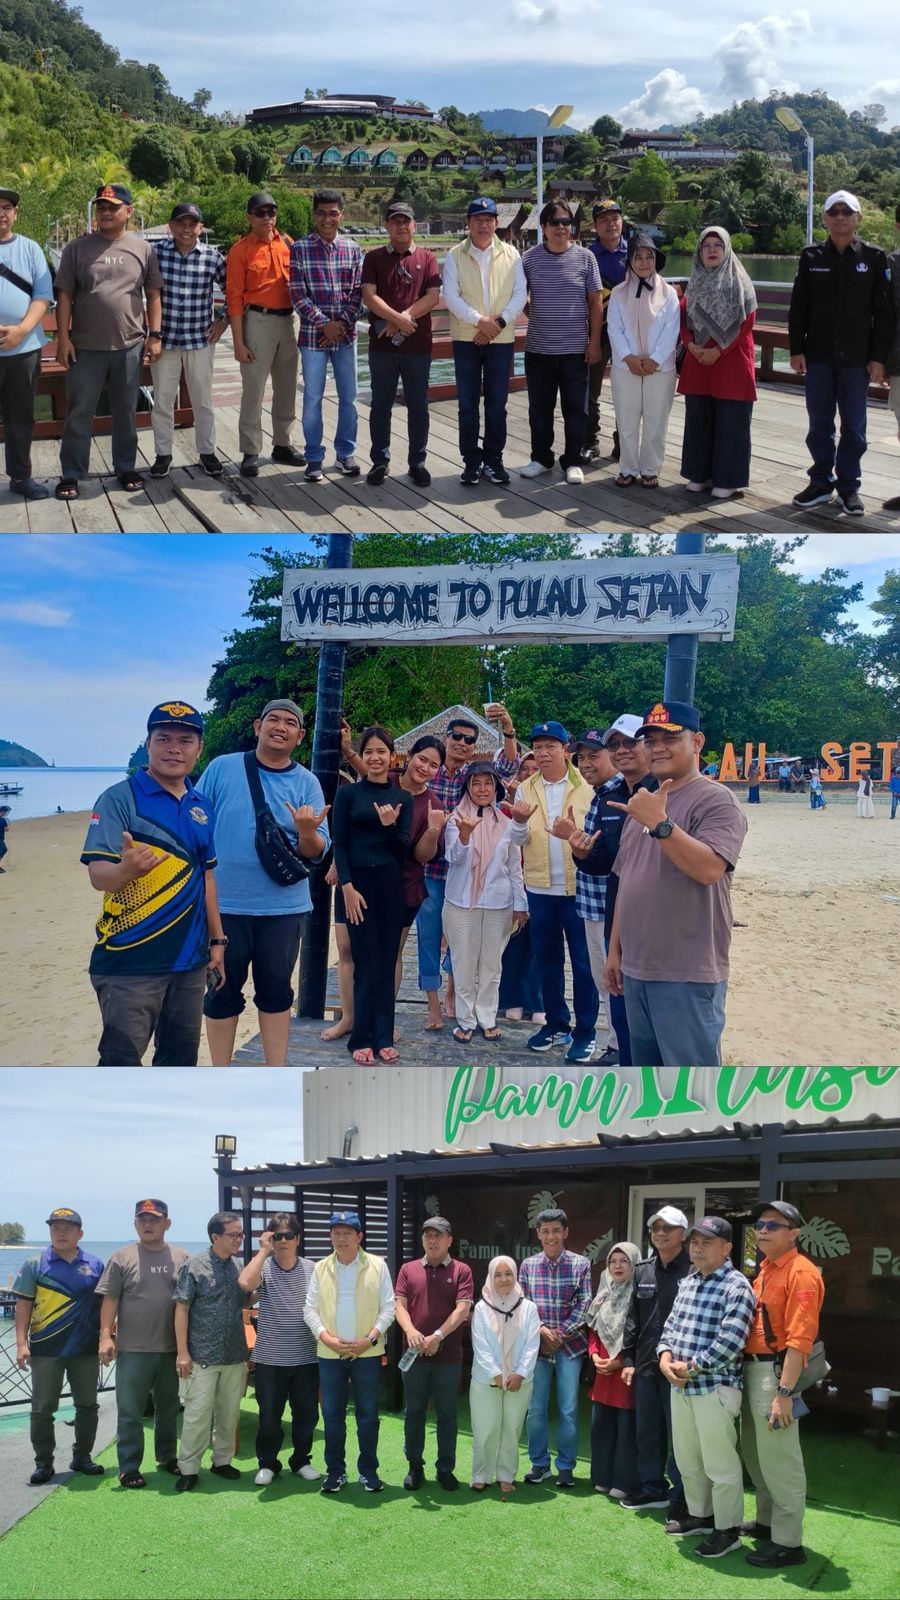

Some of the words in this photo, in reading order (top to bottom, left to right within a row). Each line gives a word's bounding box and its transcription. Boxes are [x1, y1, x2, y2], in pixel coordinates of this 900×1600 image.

[105, 256, 124, 264] NYC
[290, 582, 442, 628] WELLCOME
[448, 579, 492, 626] TO
[496, 574, 588, 624] PULAU
[594, 570, 714, 624] SETAN
[459, 1239, 500, 1259] Pamu
